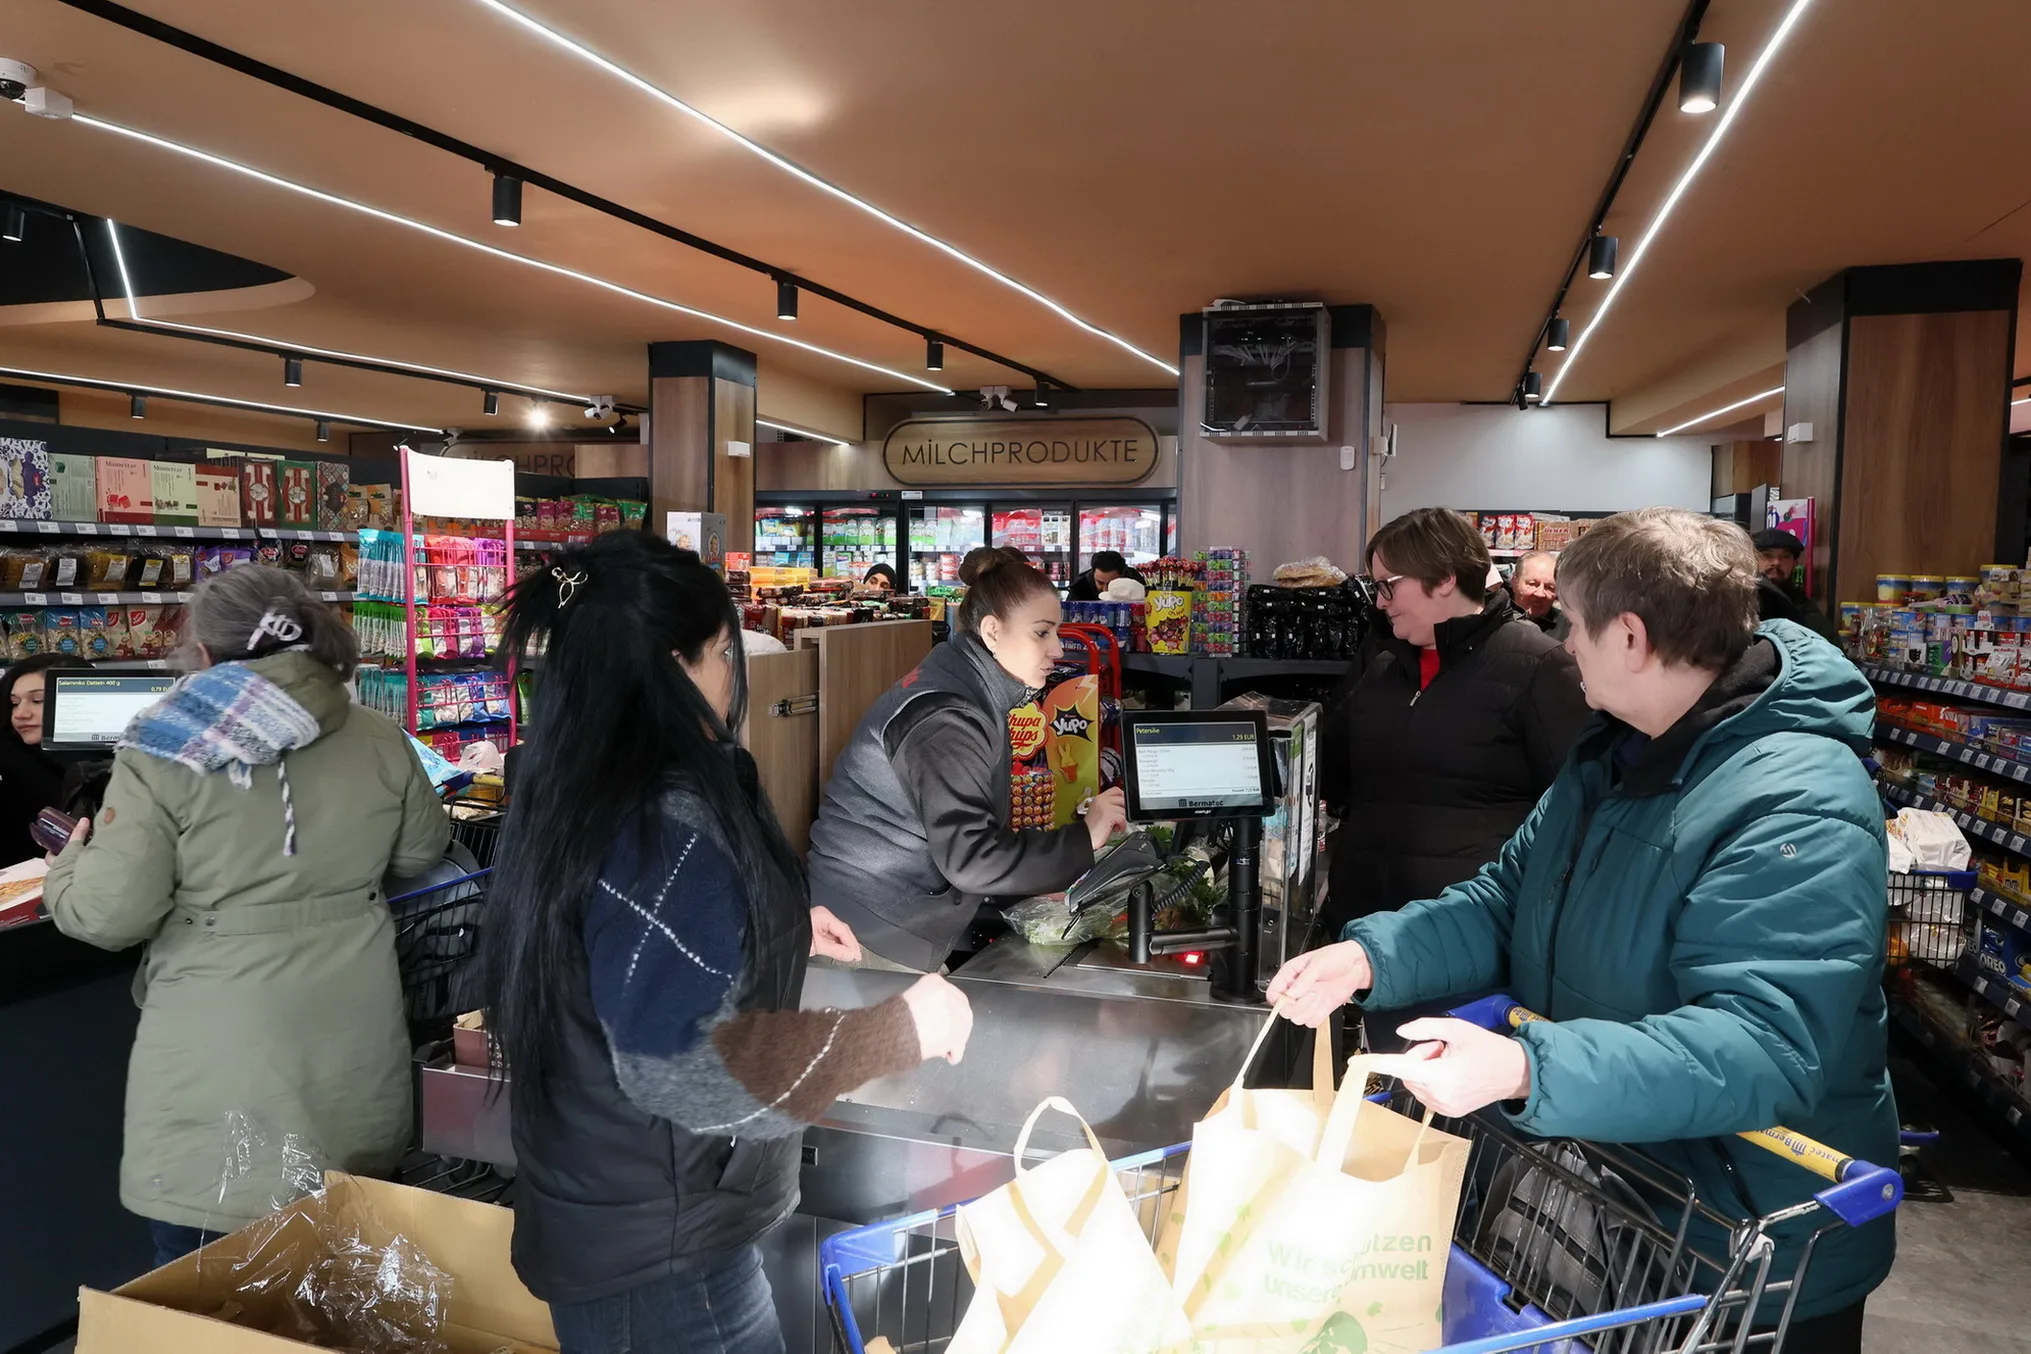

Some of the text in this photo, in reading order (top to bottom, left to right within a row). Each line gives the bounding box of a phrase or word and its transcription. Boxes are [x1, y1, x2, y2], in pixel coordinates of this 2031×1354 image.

[1136, 727, 1160, 735] Petersilie
[1188, 799, 1224, 807] Bermatec
[1979, 951, 2006, 976] OREO
